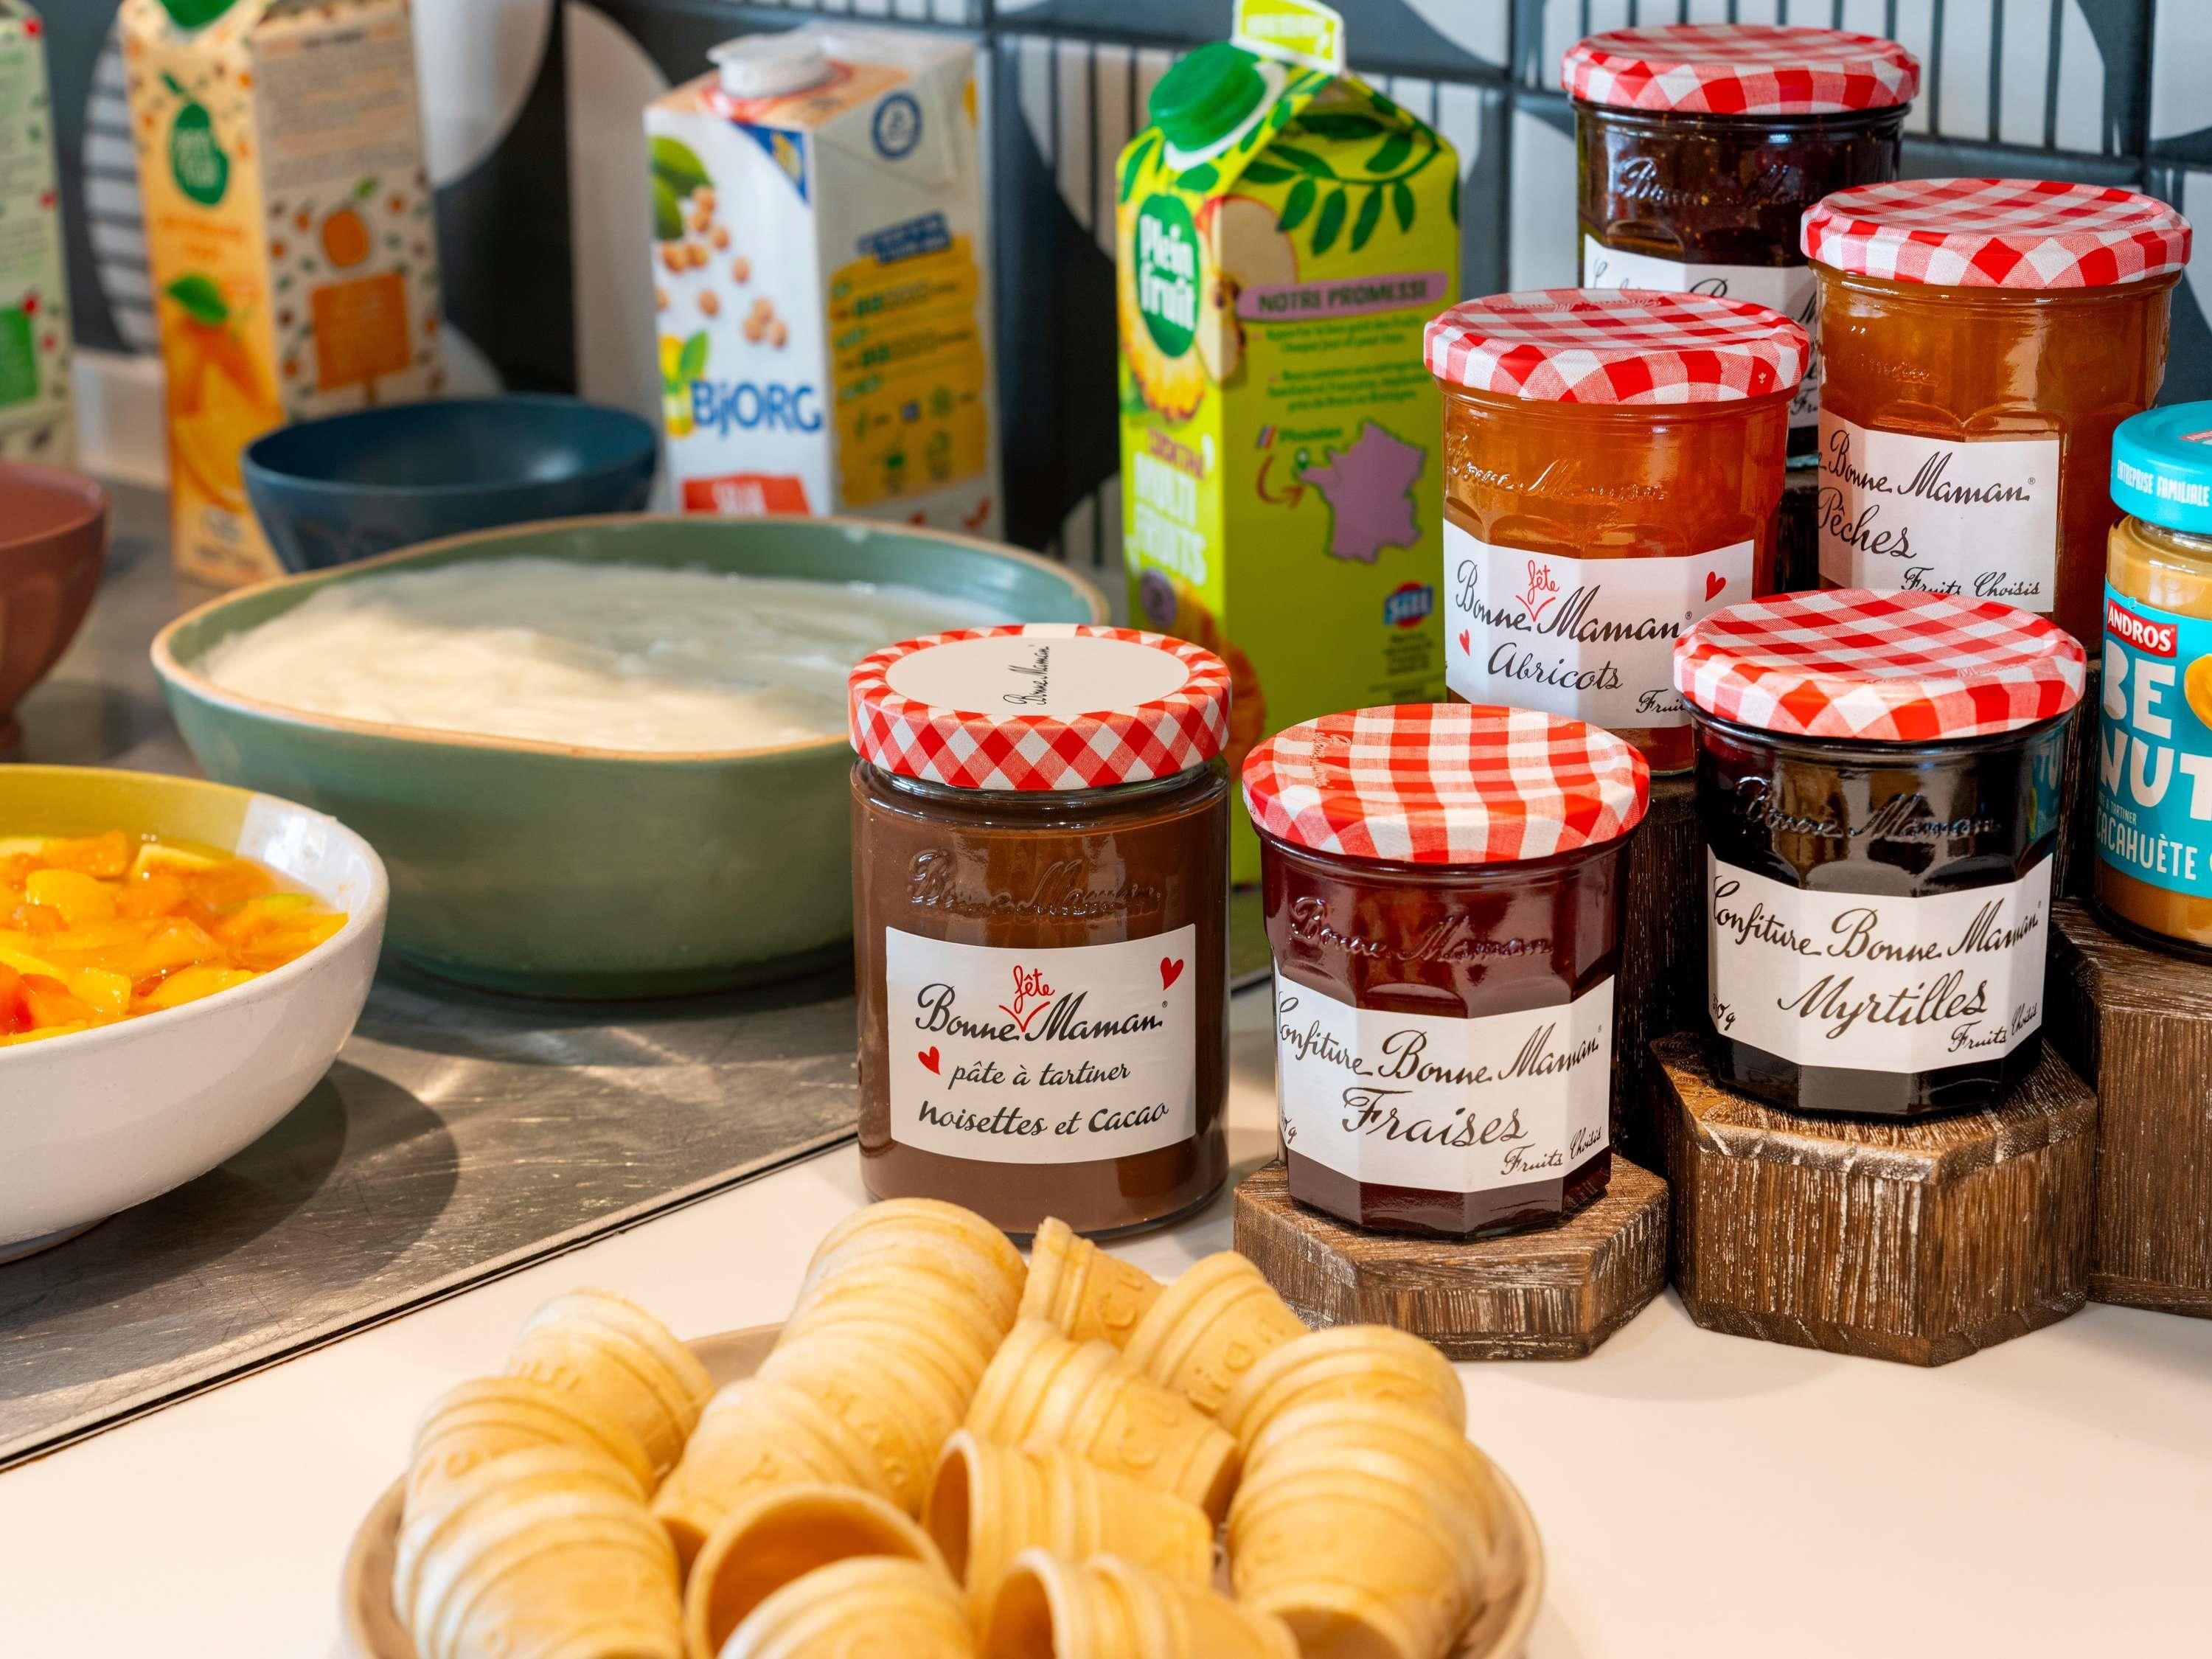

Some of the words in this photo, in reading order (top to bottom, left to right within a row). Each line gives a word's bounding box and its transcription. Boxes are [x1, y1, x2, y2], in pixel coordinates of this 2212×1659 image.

[1140, 214, 1194, 279] Plein
[1141, 261, 1194, 332] fruit
[1259, 290, 1321, 312] NOTRE
[1829, 429, 1893, 493] Bonne
[2117, 459, 2154, 495] ENTREPRISE
[2157, 476, 2211, 507] FAMILIALE
[1818, 487, 1917, 559] Pêches
[1455, 560, 1531, 633] Bonne
[1527, 560, 1559, 605] fête
[1973, 571, 2041, 597] Choisis
[2107, 605, 2171, 652] ANDROS
[1488, 642, 1622, 690] Abricots
[2104, 639, 2176, 739] BE
[2096, 806, 2197, 880] CACAHUÈTE
[1713, 874, 1821, 956] Confiture
[1827, 908, 1942, 961] Bonne
[915, 984, 1019, 1041] Bonne
[1013, 965, 1054, 1013] fête
[1777, 970, 1988, 1040] Myrtilles
[1277, 991, 1373, 1076] Confiture
[1377, 1029, 1492, 1085] Bonne
[1947, 1020, 2007, 1052] Fruits
[948, 1061, 1005, 1090] pâte
[1012, 1065, 1030, 1085] à
[1039, 1062, 1130, 1086] tartiner
[1054, 1112, 1080, 1135] et
[1343, 1087, 1528, 1146] Fraises
[1500, 1143, 1563, 1175] Fruits
[1570, 1127, 1601, 1160] Choisis
